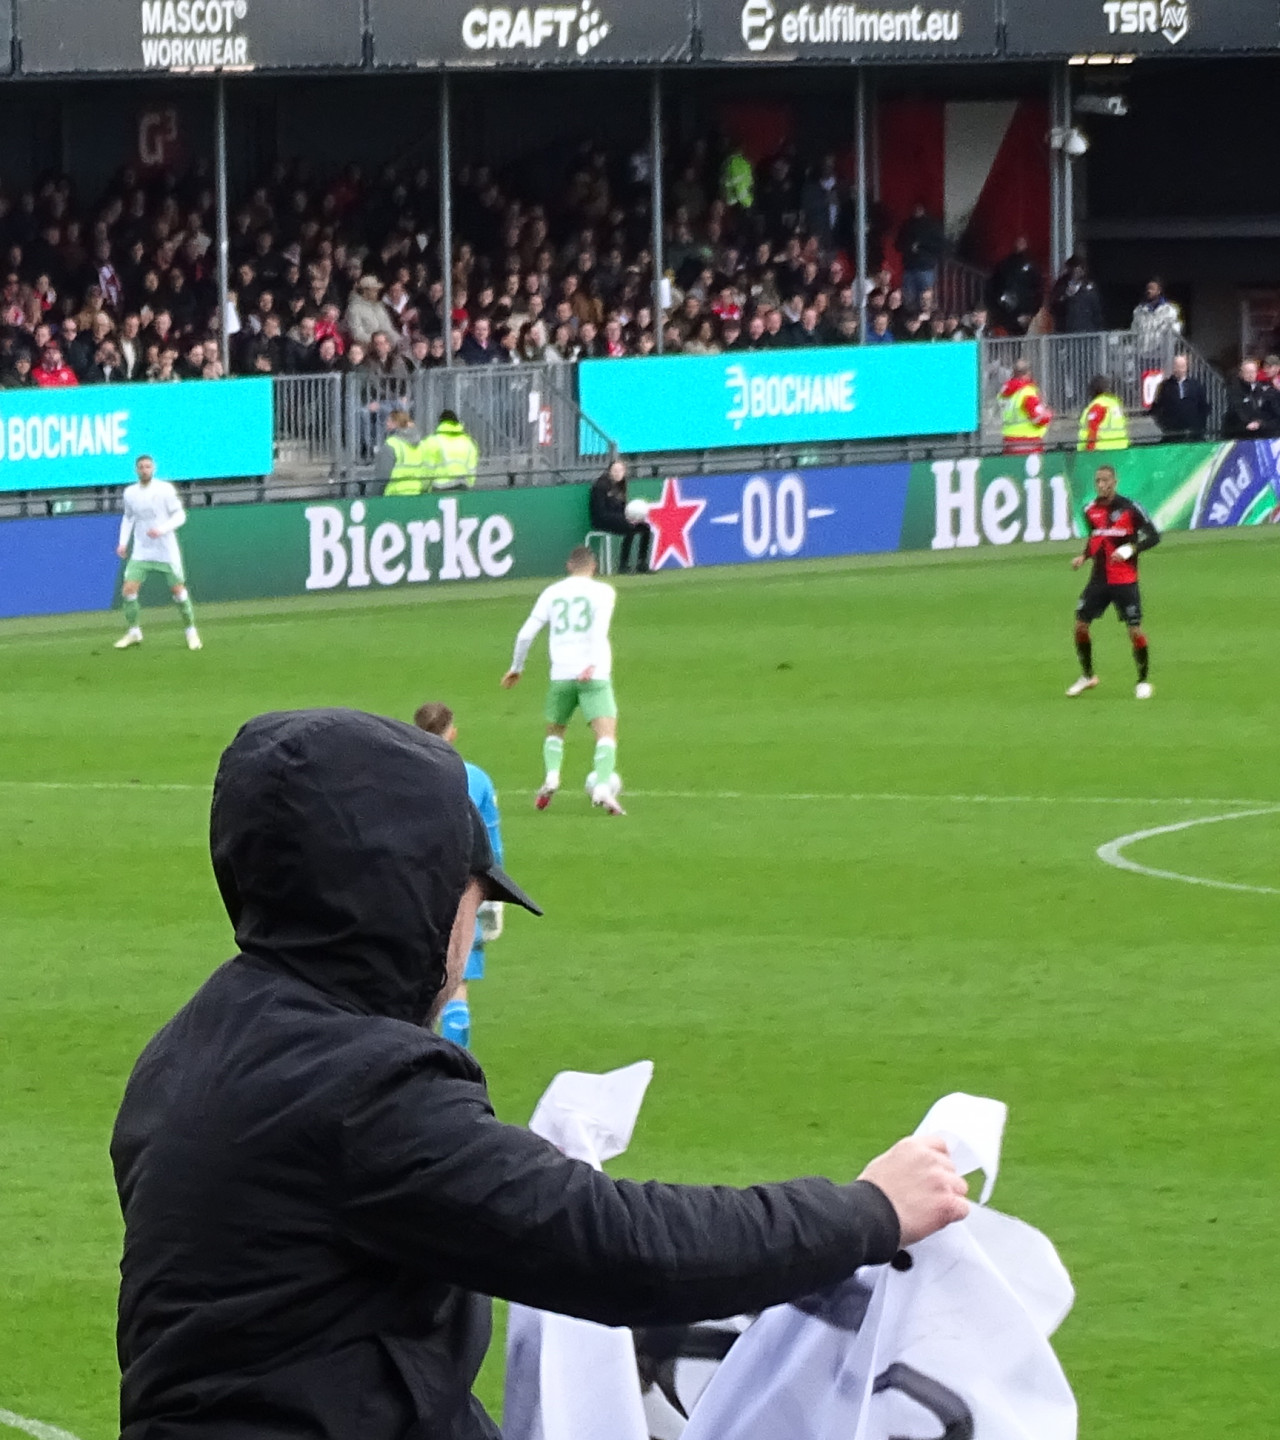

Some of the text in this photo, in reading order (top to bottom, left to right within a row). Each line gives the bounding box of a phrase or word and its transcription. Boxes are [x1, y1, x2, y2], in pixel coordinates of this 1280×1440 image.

[462, 8, 578, 50] CRAFT
[781, 4, 960, 43] efulfilment.eu
[1102, 1, 1157, 34] TSR
[141, 36, 247, 67] WORKWEAR
[748, 370, 856, 416] BOCHANE
[9, 411, 130, 461] BOCHANE
[743, 476, 805, 557] 0.0
[304, 498, 514, 590] Bierke
[551, 596, 593, 635] 33
